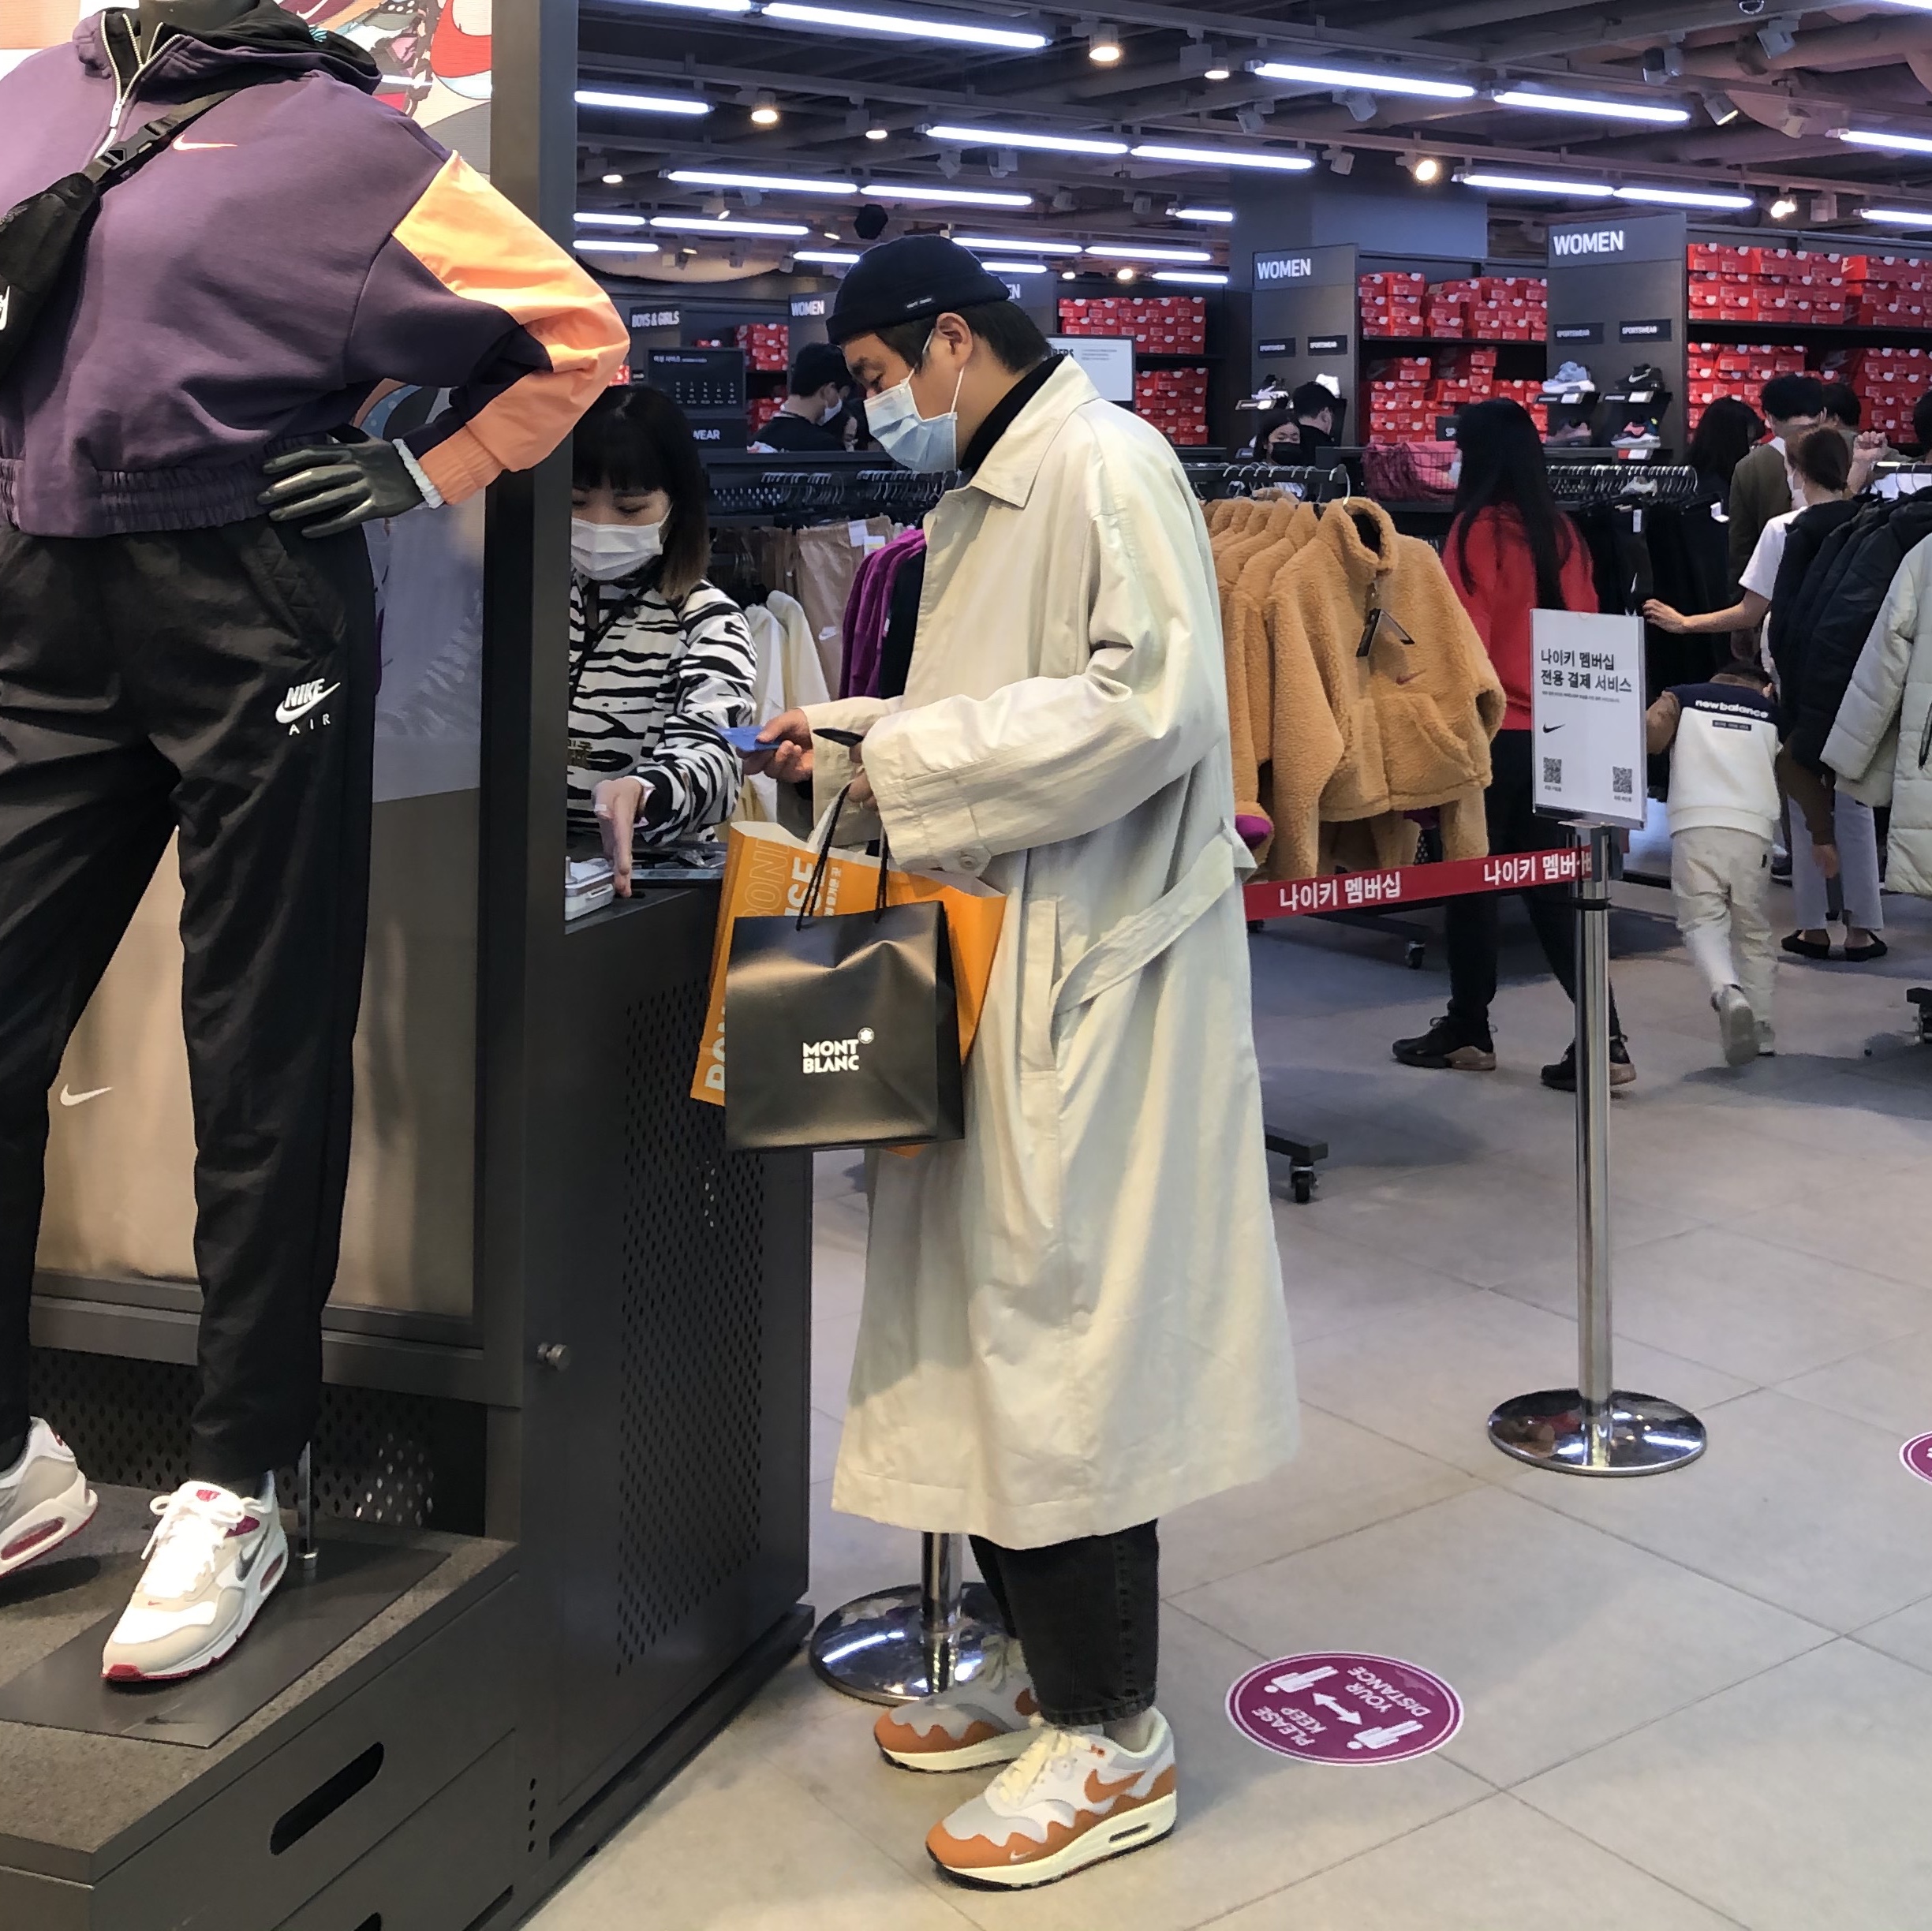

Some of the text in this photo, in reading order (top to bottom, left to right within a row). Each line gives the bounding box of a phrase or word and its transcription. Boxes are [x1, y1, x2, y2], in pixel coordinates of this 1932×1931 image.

[1553, 230, 1624, 256] WOMEN
[1257, 258, 1312, 280] WOMEN
[790, 300, 825, 317] WOMEN
[1541, 648, 1614, 670] 나이키 멤버십
[285, 678, 325, 708] NIKE
[1541, 669, 1632, 693] 전용 결제 서비스
[289, 713, 331, 735] AIR
[1484, 851, 1580, 886] 나이키 멤버
[1280, 872, 1401, 911] 나이키 멤버십
[803, 1039, 859, 1057] MONT
[803, 1055, 859, 1074] BLANC
[1344, 1683, 1392, 1713] YOUR
[1347, 1666, 1432, 1716] DISTANCE
[1251, 1705, 1315, 1746] PLEASE
[1280, 1707, 1327, 1734] KEEP
